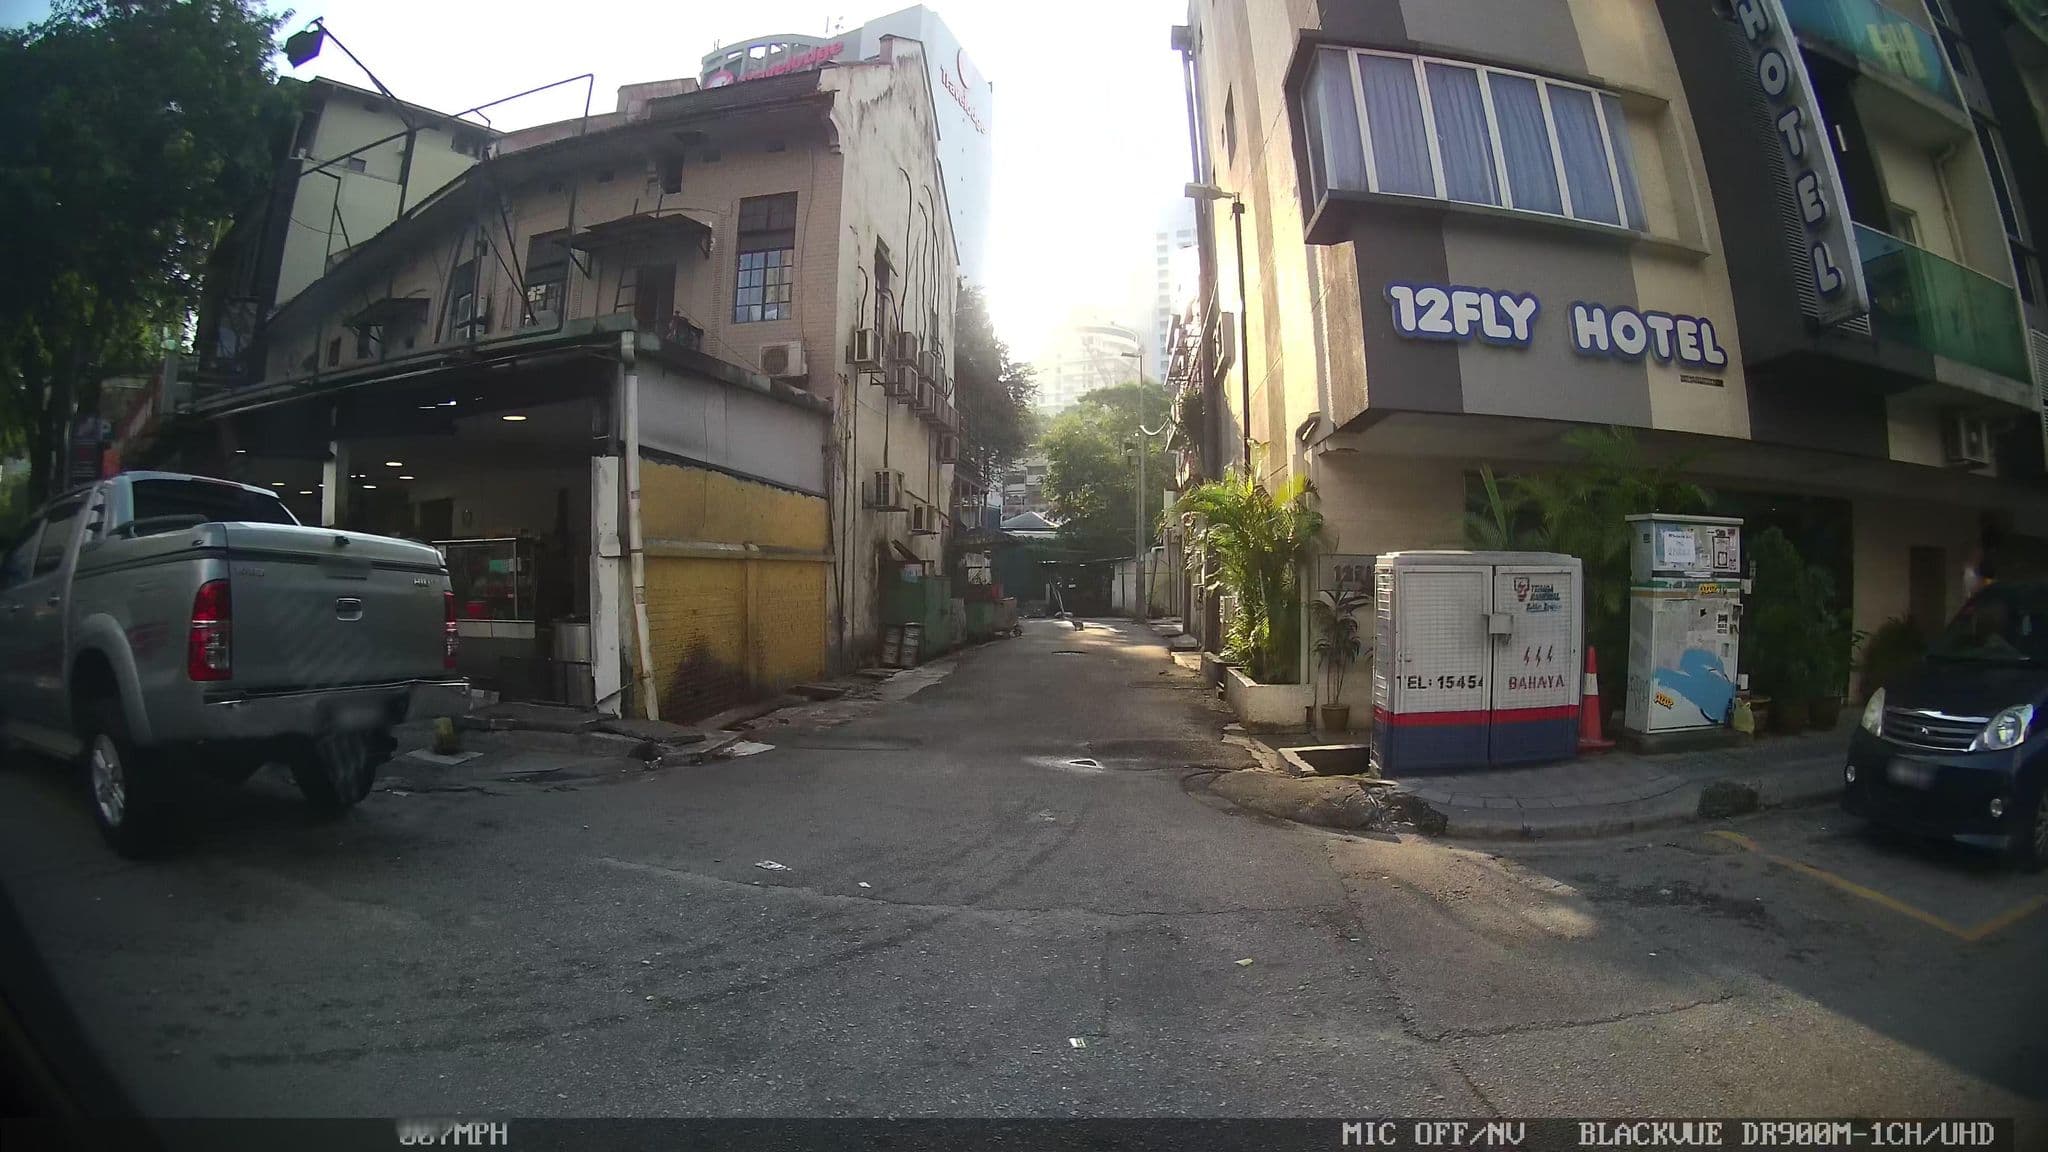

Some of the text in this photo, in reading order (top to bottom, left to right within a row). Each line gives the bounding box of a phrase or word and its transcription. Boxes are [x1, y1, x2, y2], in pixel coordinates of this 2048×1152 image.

[1737, 0, 1841, 293] HOTEL
[1389, 284, 1725, 365] 12FLY HOTEL
[1396, 675, 1432, 690] TEL:
[1508, 674, 1565, 690] BAHAYA
